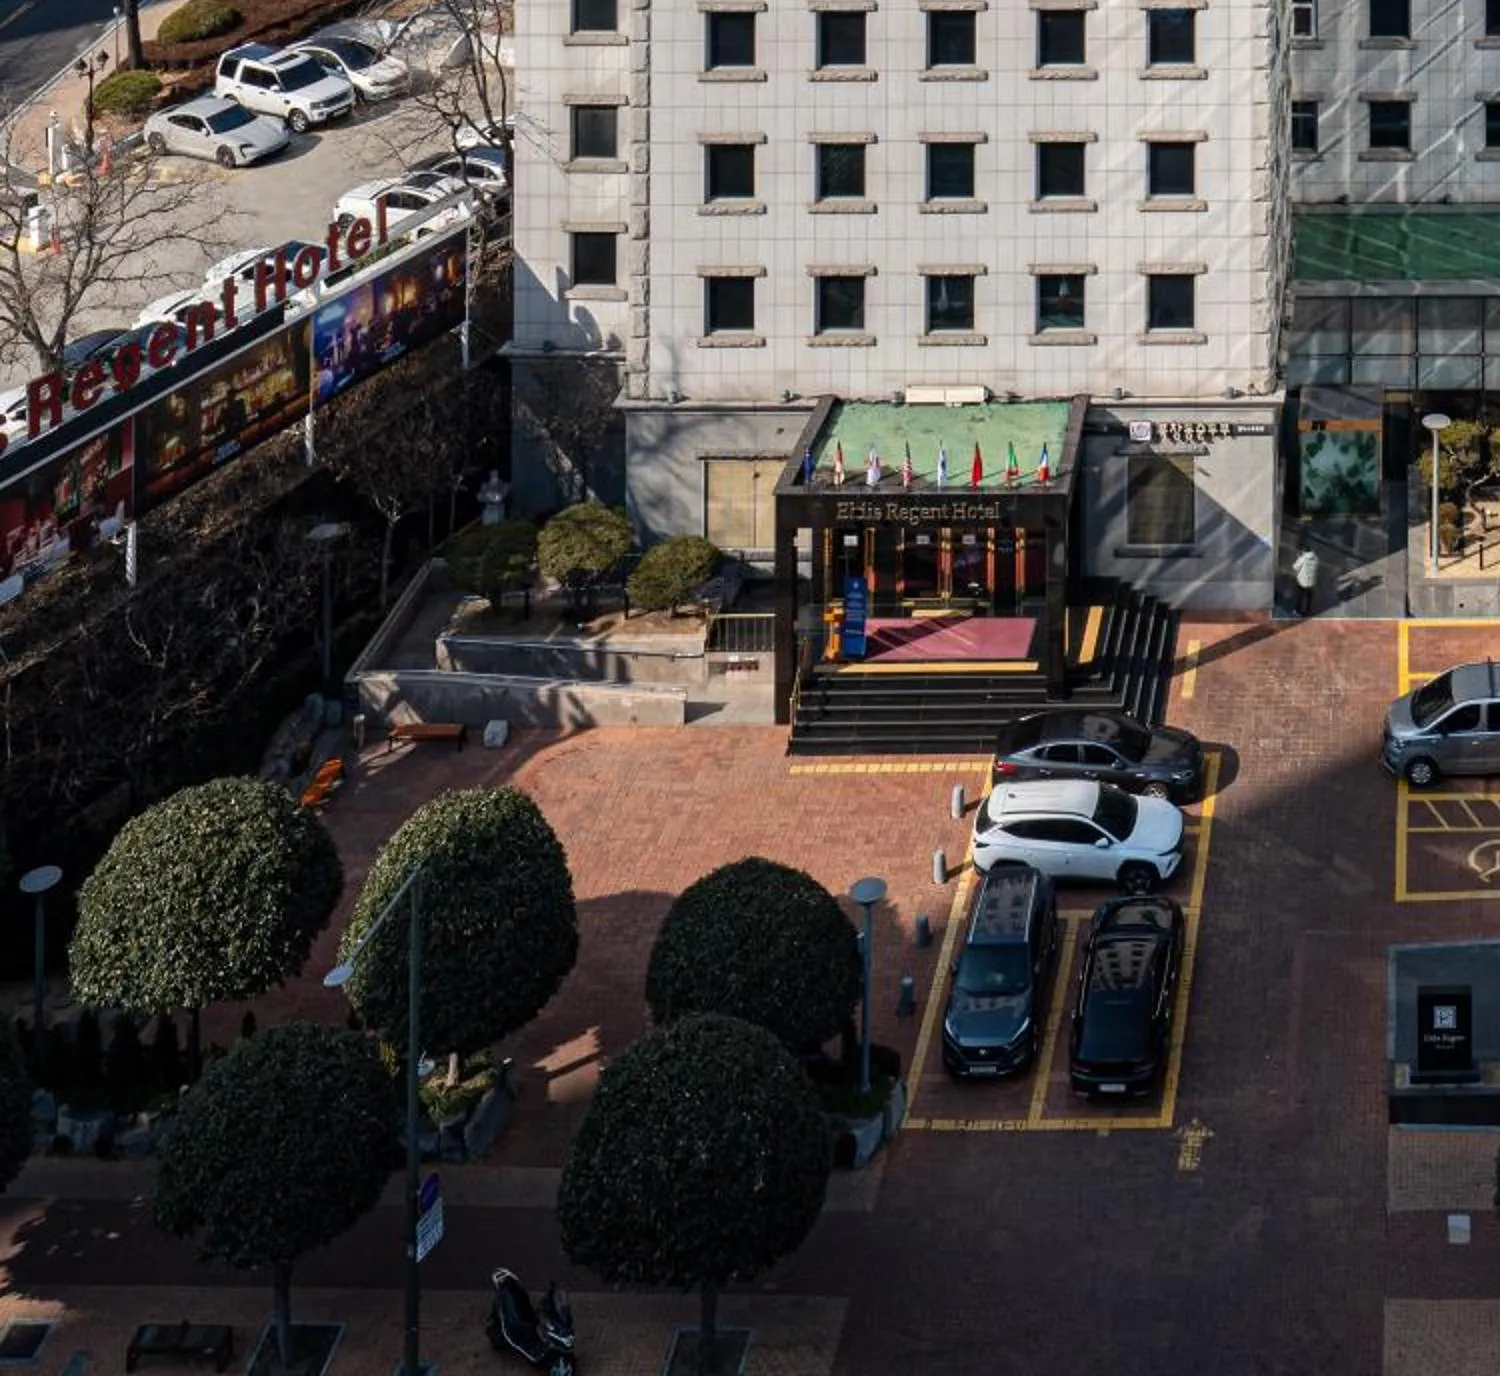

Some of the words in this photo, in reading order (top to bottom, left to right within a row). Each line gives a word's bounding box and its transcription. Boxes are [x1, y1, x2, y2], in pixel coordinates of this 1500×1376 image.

[26, 275, 239, 440] Regent
[254, 195, 389, 314] Hotel
[836, 501, 882, 520] Eldis
[886, 502, 950, 525] Regent
[952, 501, 1001, 519] Hotel
